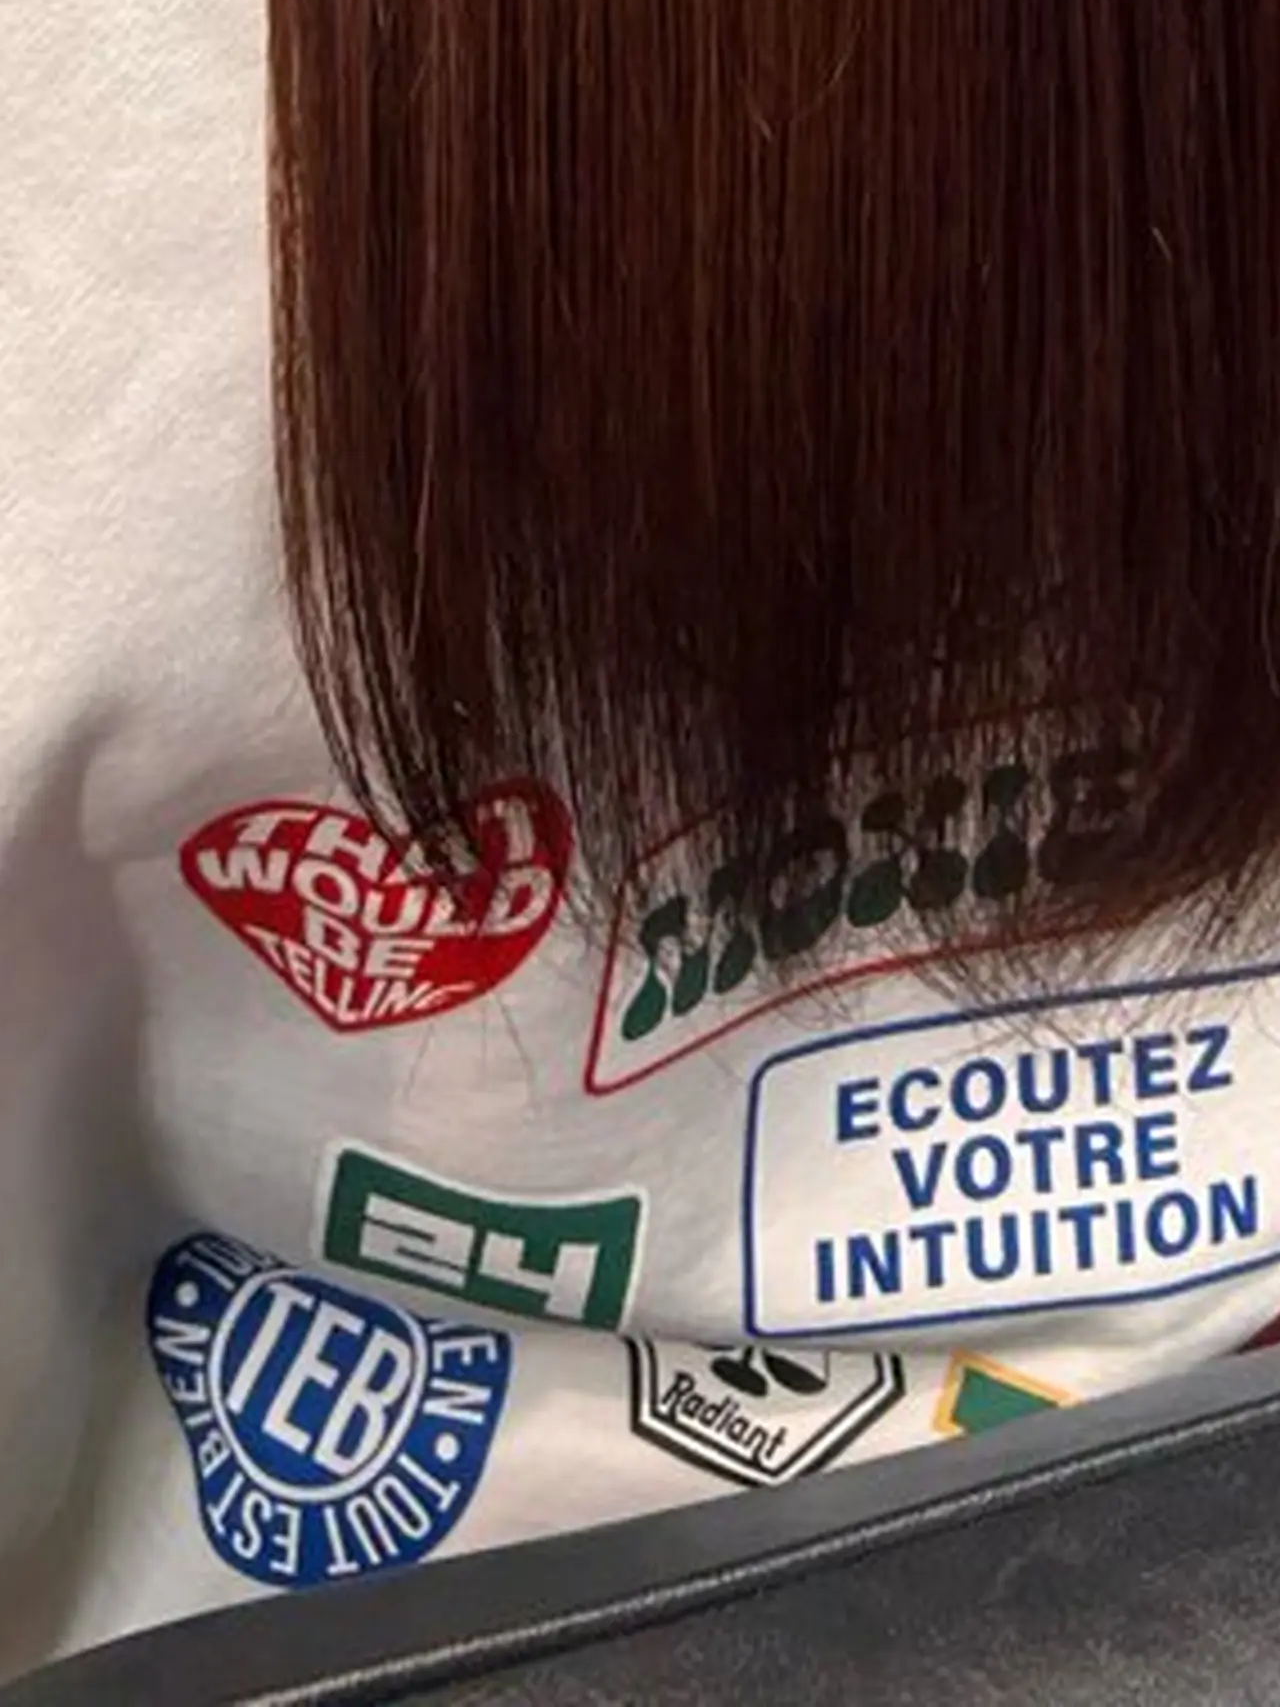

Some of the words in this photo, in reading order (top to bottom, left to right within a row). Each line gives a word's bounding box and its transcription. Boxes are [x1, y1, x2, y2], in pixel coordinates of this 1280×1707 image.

[196, 848, 554, 936] WOULD
[304, 909, 434, 978] BE
[835, 1025, 1234, 1143] ECOUTEZ
[892, 1112, 1180, 1209] VOTRE
[816, 1175, 1258, 1302] INTUITION
[153, 1317, 230, 1476] BIEN
[226, 1282, 415, 1478] TEB
[660, 1370, 789, 1463] Radiant
[206, 1474, 303, 1577] EST
[326, 1451, 459, 1577] TOUT
